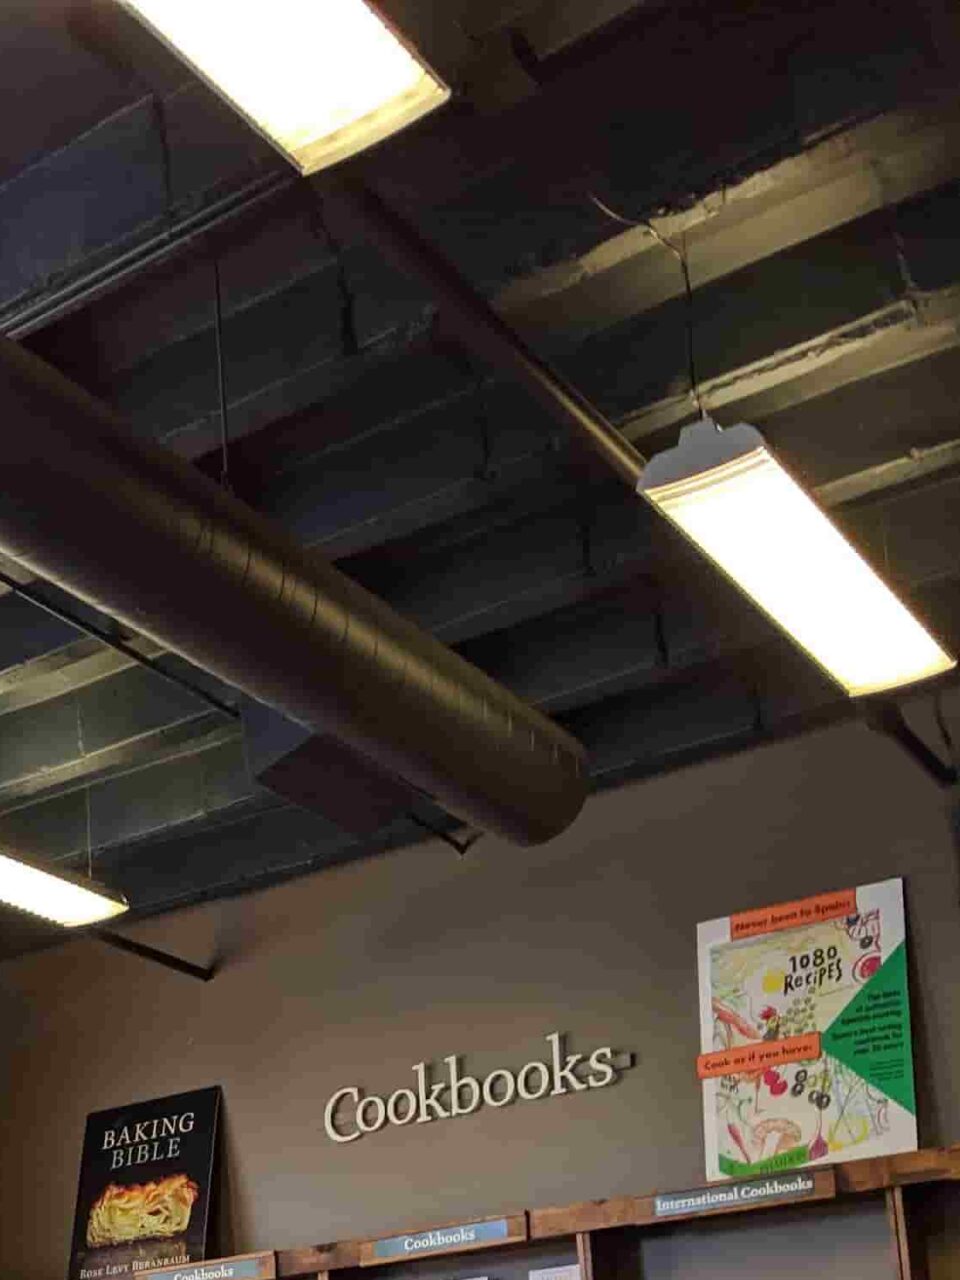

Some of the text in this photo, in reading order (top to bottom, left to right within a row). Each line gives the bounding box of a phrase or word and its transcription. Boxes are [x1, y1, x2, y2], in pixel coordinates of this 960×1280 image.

[788, 945, 838, 974] 1080
[323, 1031, 615, 1142] Cookbooks
[101, 1111, 196, 1150] BAKING
[110, 1137, 182, 1170] BIBLE
[655, 1177, 814, 1211] International Cookbooks
[403, 1228, 476, 1252] Cookbooks
